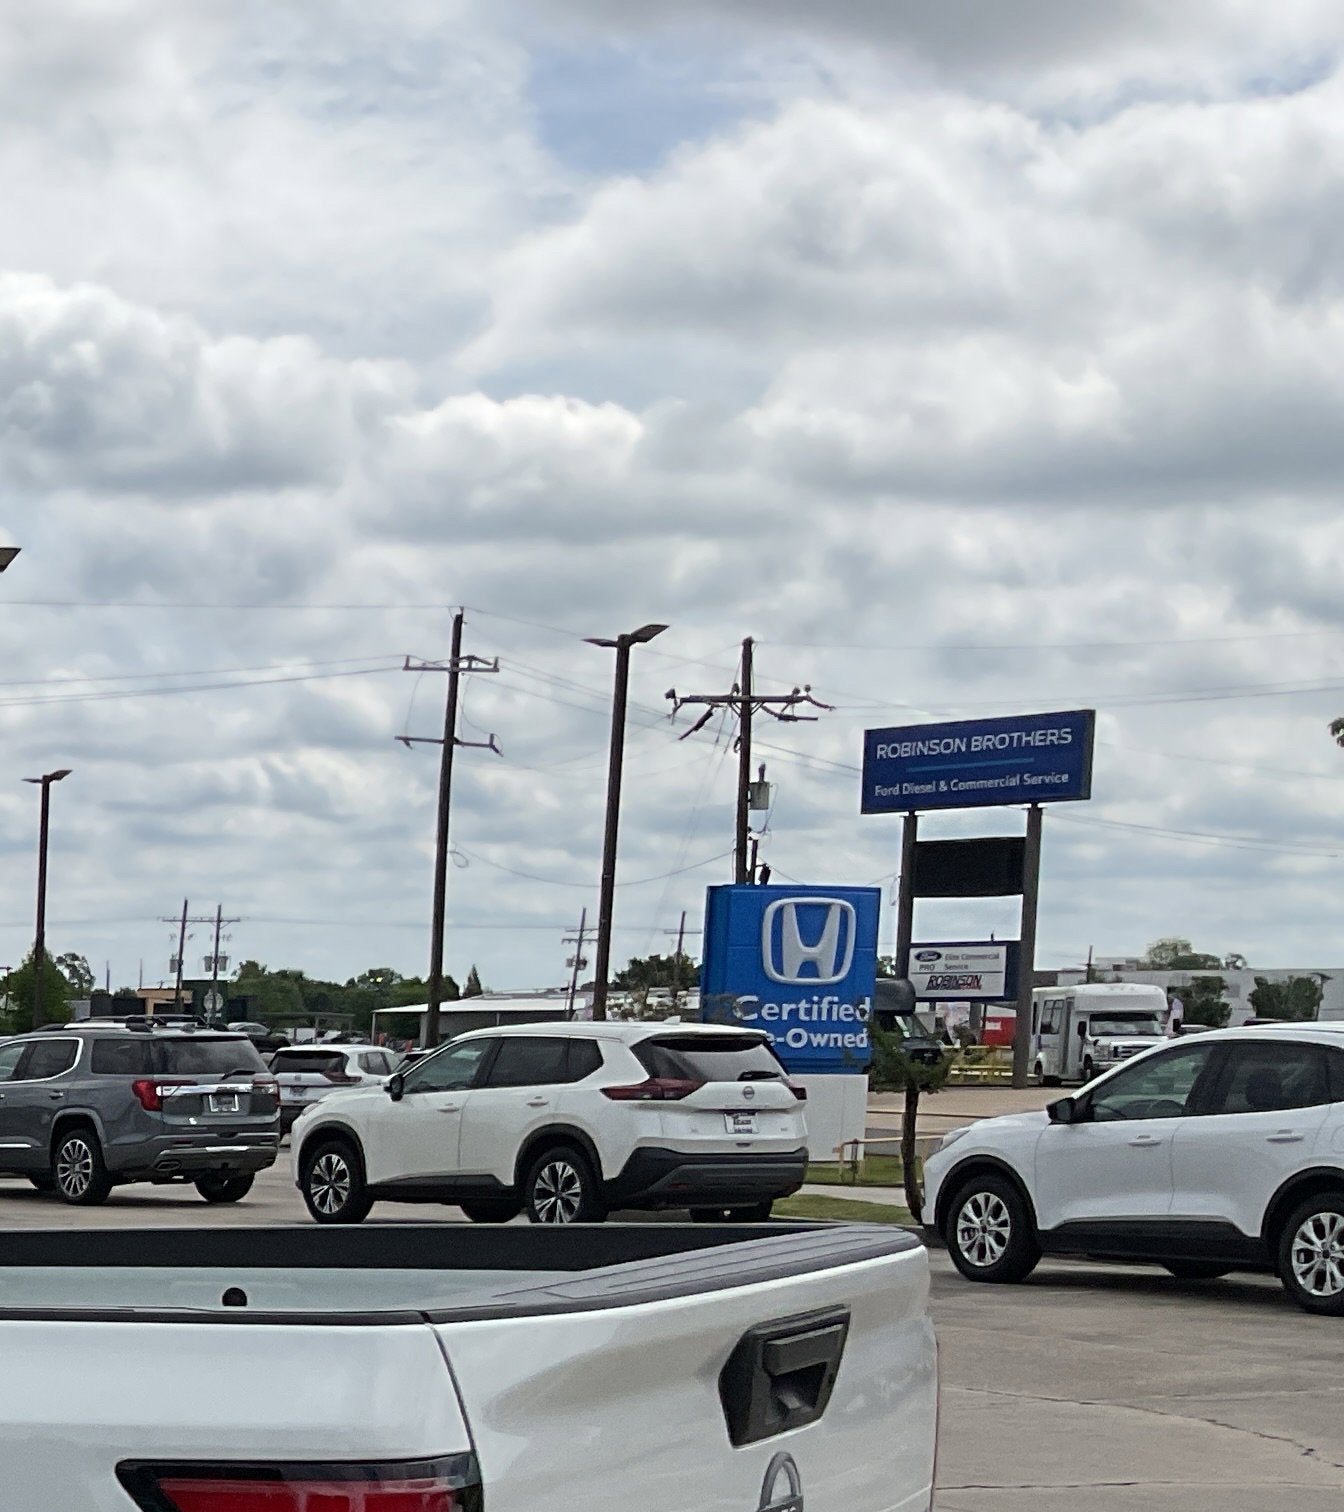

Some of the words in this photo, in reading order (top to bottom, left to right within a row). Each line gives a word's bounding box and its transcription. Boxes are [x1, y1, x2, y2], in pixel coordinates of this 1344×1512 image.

[876, 738, 966, 760] ROBINSON
[970, 728, 1072, 752] BROTHERS
[874, 783, 900, 796] Ford
[902, 780, 936, 794] Diesel
[939, 780, 948, 791] &
[950, 774, 1020, 791] Commercial
[1023, 771, 1069, 784] Service
[733, 995, 871, 1022] Certified
